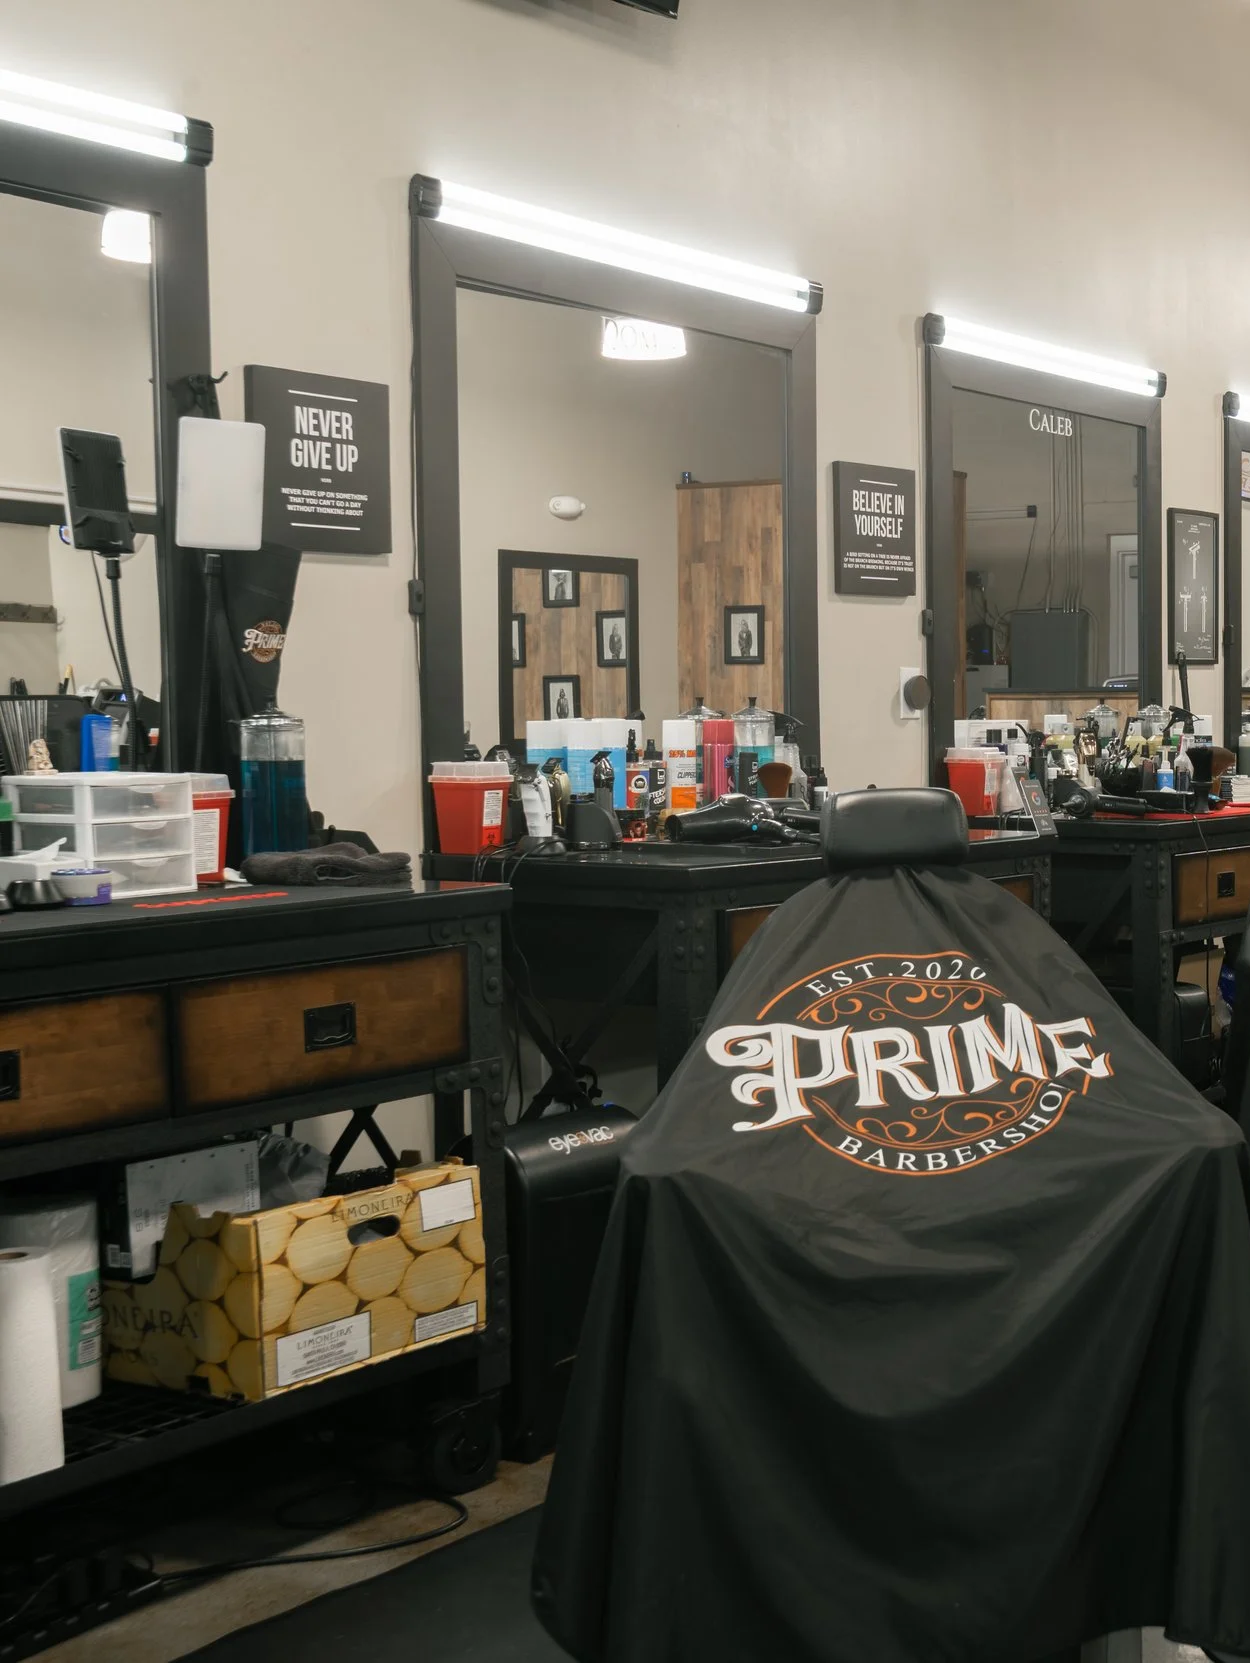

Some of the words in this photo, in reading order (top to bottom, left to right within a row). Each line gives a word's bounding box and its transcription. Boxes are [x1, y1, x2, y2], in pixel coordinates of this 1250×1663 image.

[294, 405, 354, 440] NEVER
[291, 438, 332, 470] GIVE
[335, 443, 359, 472] UP
[852, 489, 893, 515] BELIEVE
[894, 494, 905, 516] IN
[854, 514, 903, 538] YOURSELF
[242, 628, 286, 652] PRIME
[705, 1002, 1113, 1132] PRIME
[331, 1192, 415, 1223] LIMONEIRA
[296, 1325, 353, 1350] LIMONEIRA
